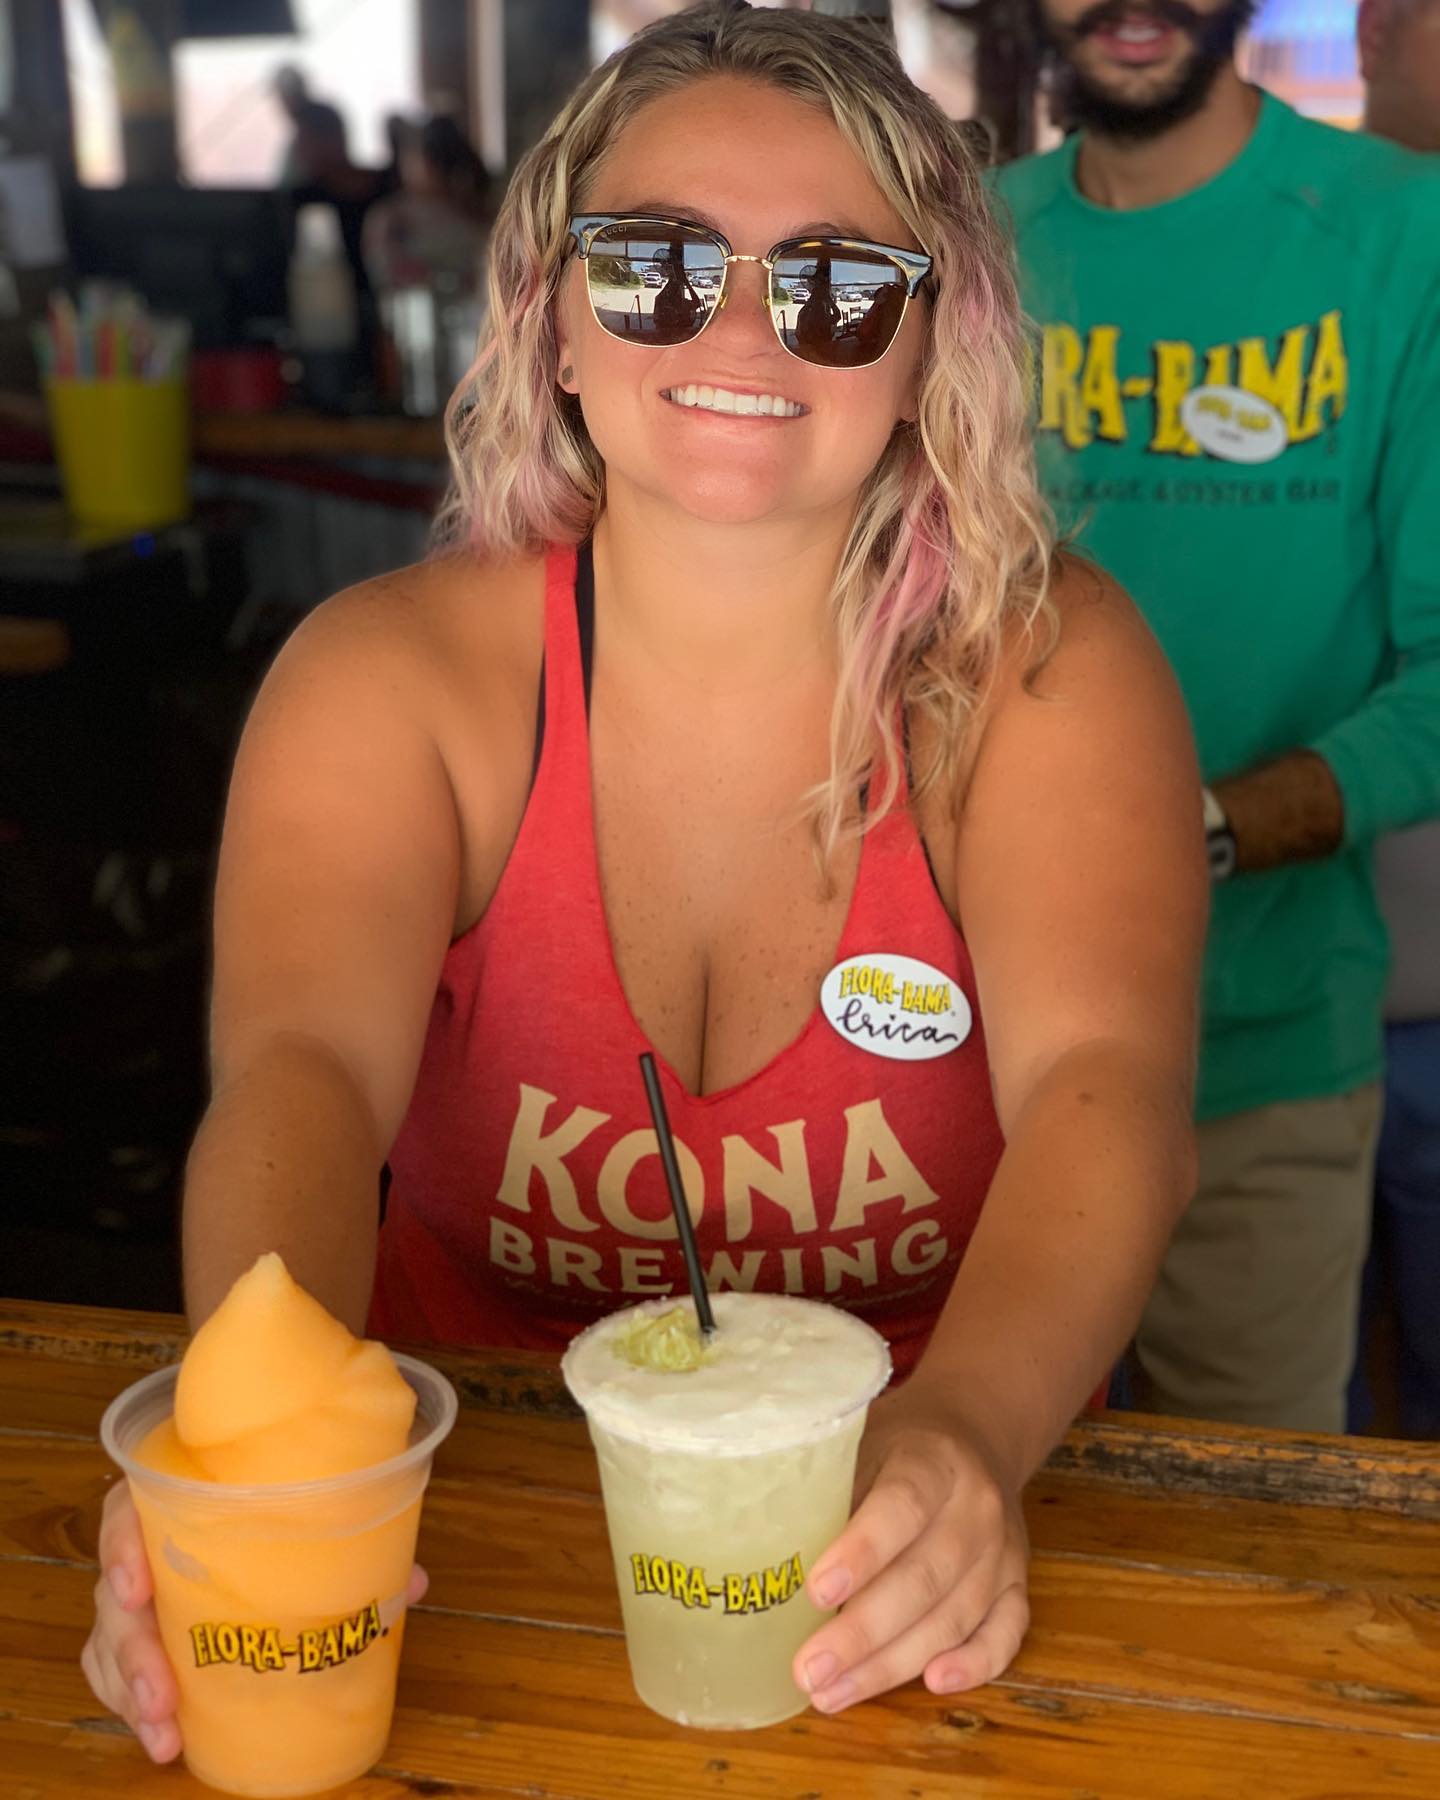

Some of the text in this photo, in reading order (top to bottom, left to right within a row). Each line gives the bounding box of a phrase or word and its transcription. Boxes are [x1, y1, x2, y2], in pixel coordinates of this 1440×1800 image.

[838, 965, 952, 1015] FLORA-BAMA
[495, 1083, 940, 1243] KONA
[489, 1219, 948, 1294] BREWING
[631, 1552, 805, 1615] FLORA-BAMA
[190, 1598, 382, 1673] FLORA-BAMA
